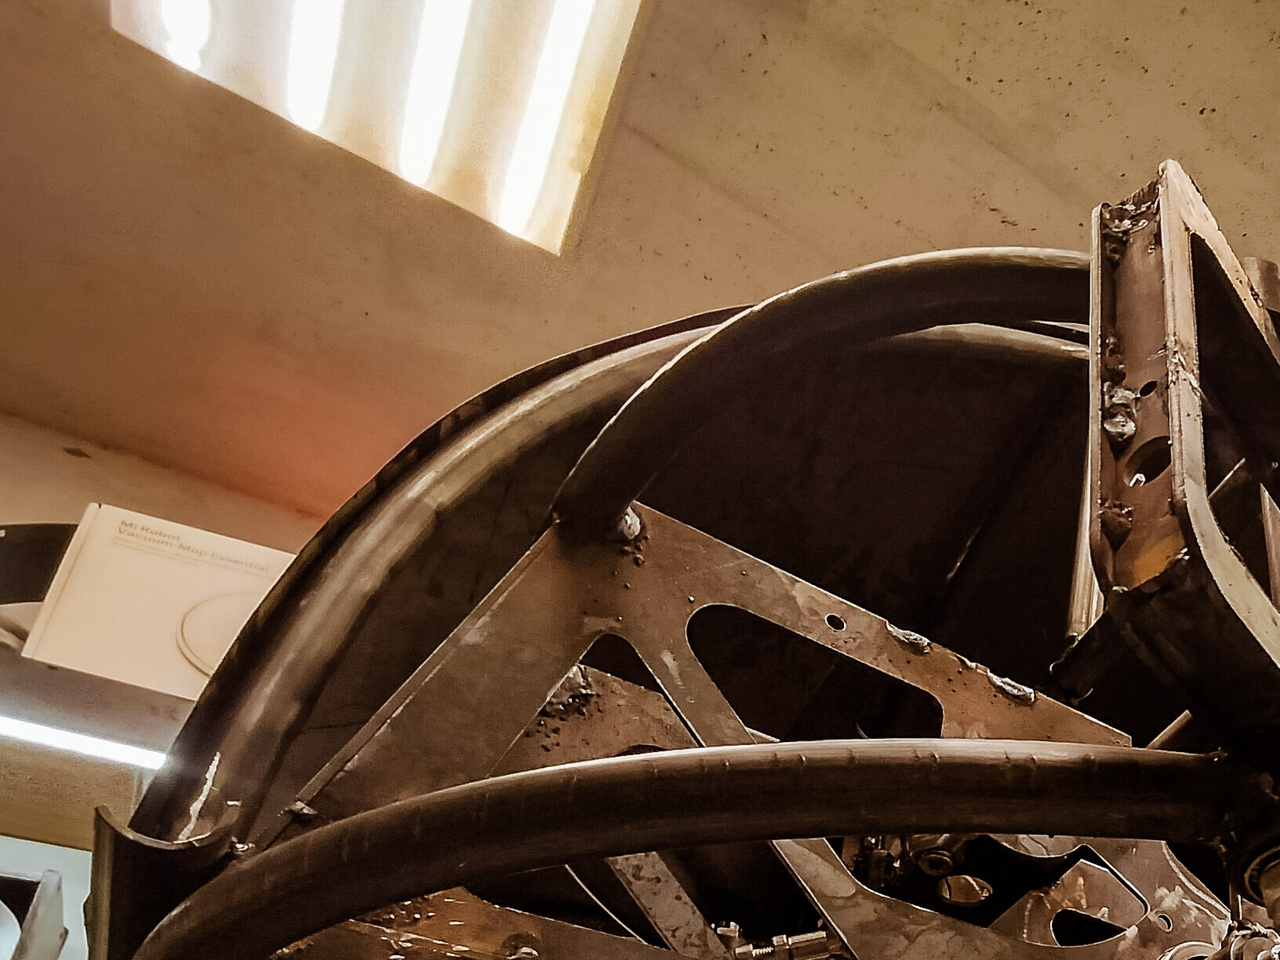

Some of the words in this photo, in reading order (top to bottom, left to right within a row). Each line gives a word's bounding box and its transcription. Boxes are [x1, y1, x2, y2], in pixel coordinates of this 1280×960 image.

[121, 520, 137, 531] Mi
[141, 526, 181, 541] Robot
[211, 552, 270, 572] Essential
